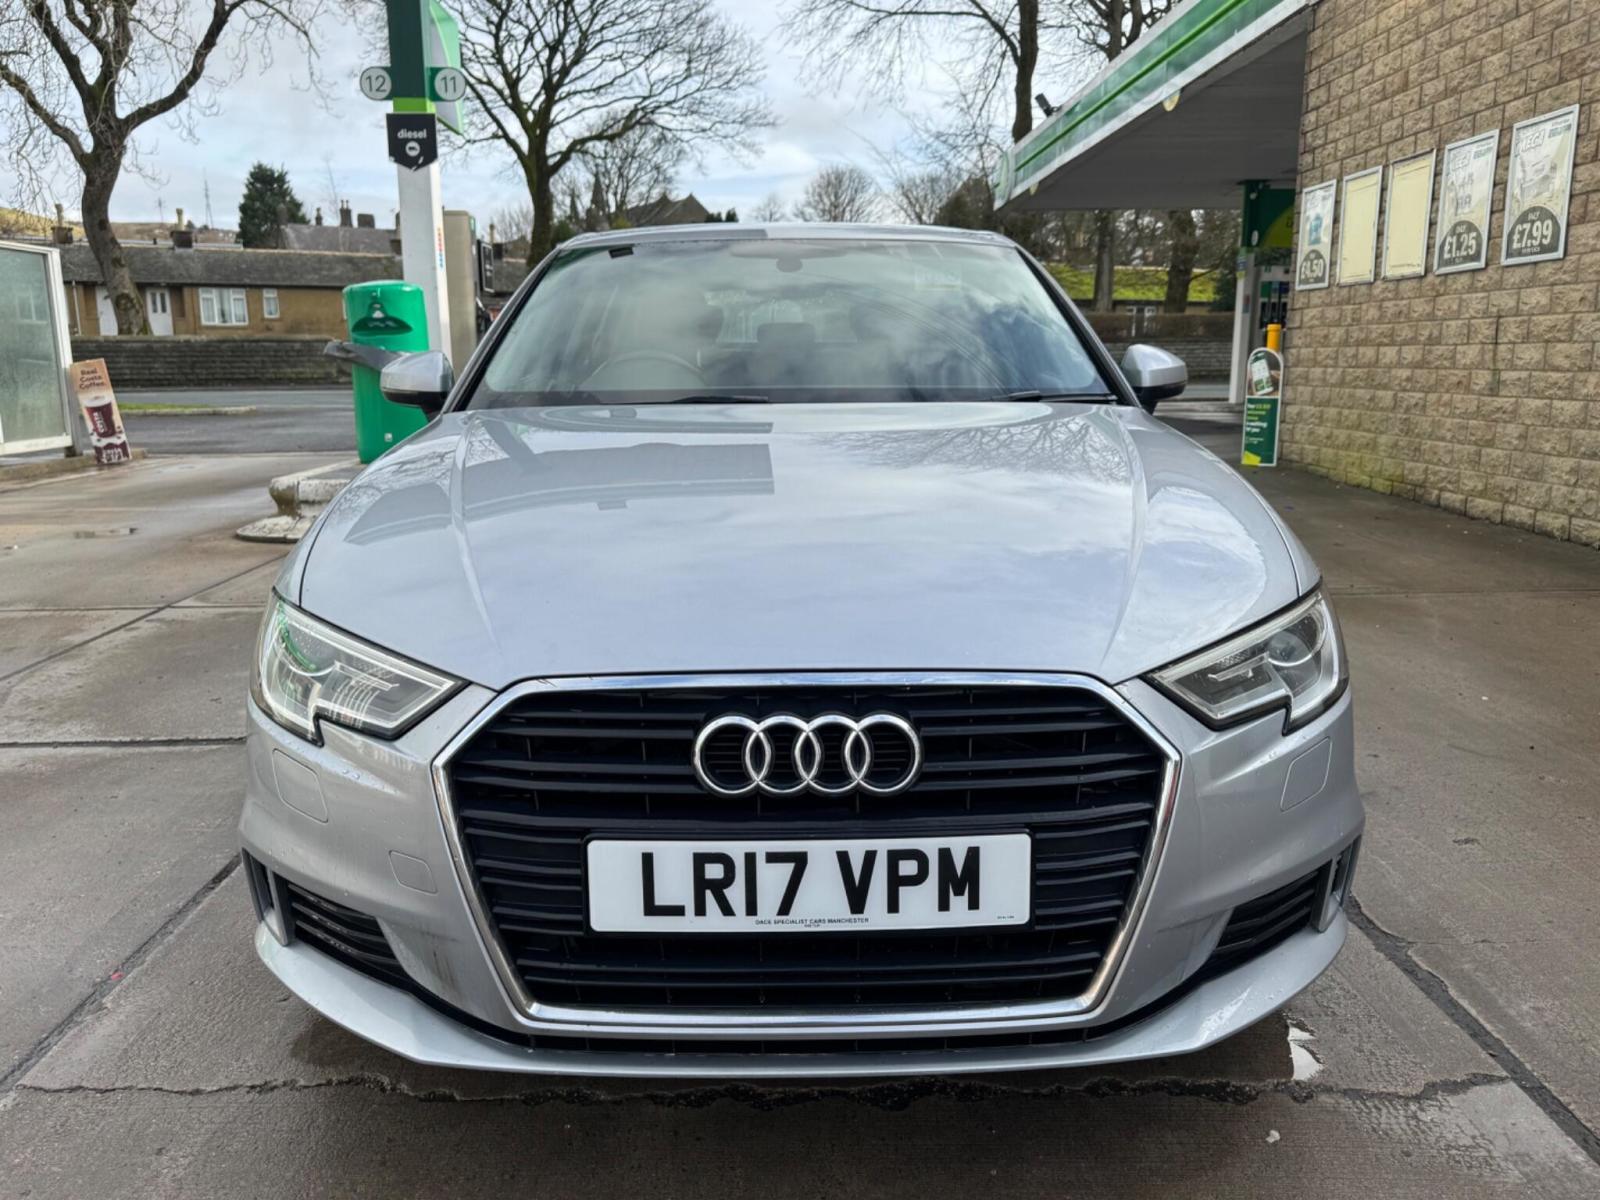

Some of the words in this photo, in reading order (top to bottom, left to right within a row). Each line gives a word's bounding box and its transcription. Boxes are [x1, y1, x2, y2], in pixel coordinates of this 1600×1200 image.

[365, 74, 387, 93] 12
[440, 75, 458, 94] 11
[397, 128, 427, 139] diesel
[1512, 219, 1553, 249] £7.99
[1443, 232, 1477, 260] £1.25
[641, 851, 809, 917] LR17
[835, 846, 981, 914] VPM
